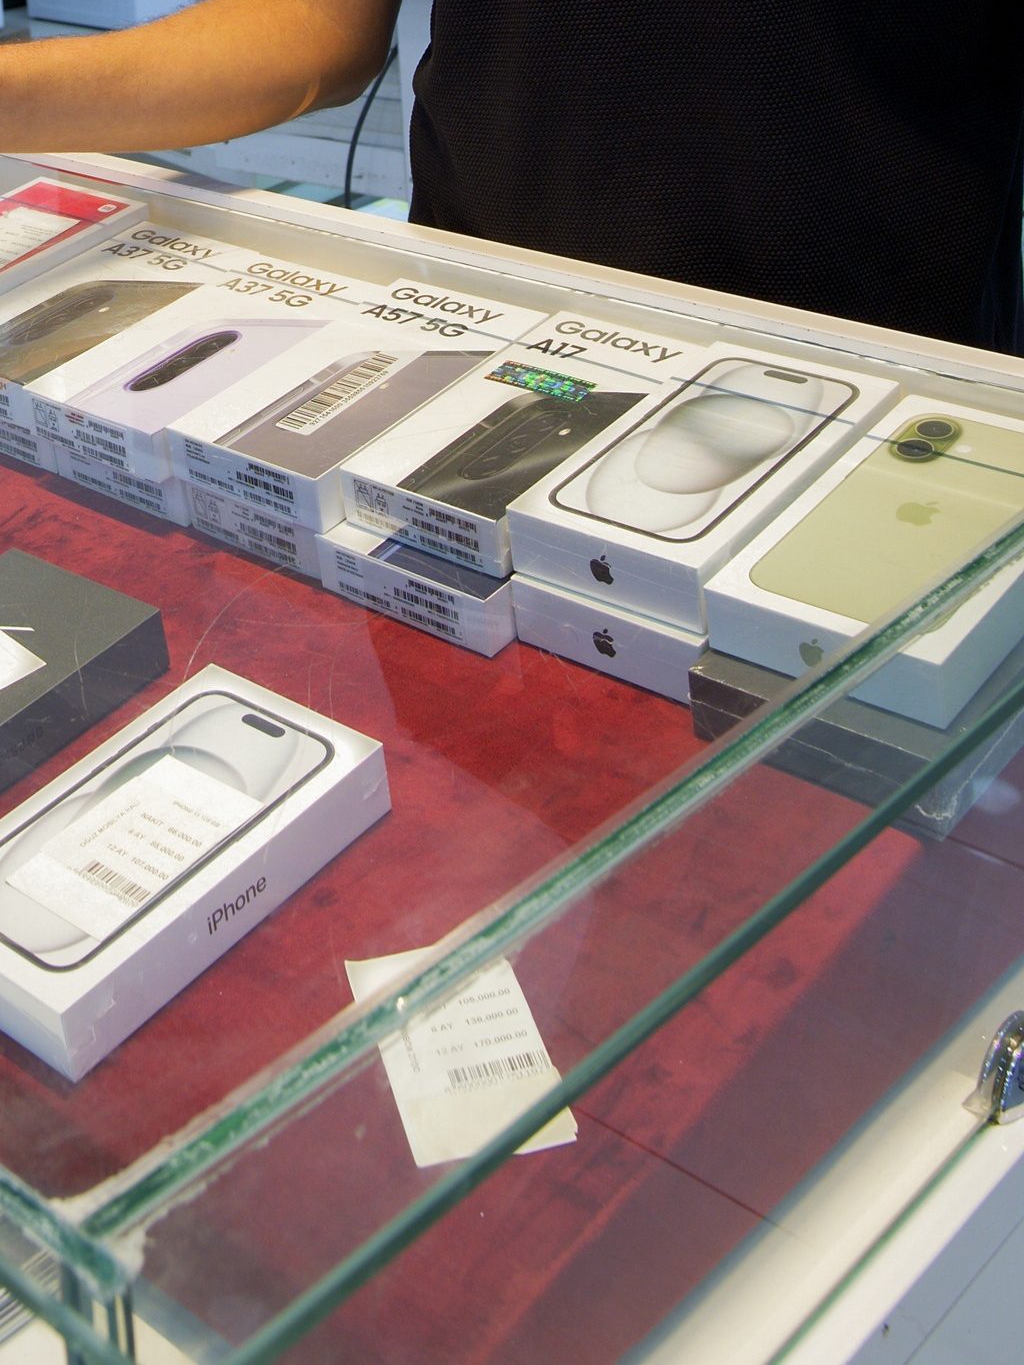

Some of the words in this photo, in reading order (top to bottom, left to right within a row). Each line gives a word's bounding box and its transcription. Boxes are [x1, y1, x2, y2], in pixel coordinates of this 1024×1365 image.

[102, 242, 151, 260] A37
[147, 251, 187, 271] 5G
[131, 228, 221, 261] Galaxy
[216, 277, 273, 295] A37
[268, 288, 313, 308] 5G
[247, 262, 349, 296] Galaxy
[361, 304, 424, 325] A57
[420, 317, 469, 338] 5G
[391, 287, 504, 324] Galaxy
[525, 338, 588, 359] A17
[555, 320, 684, 363] Galaxy
[207, 875, 267, 935] iPhone
